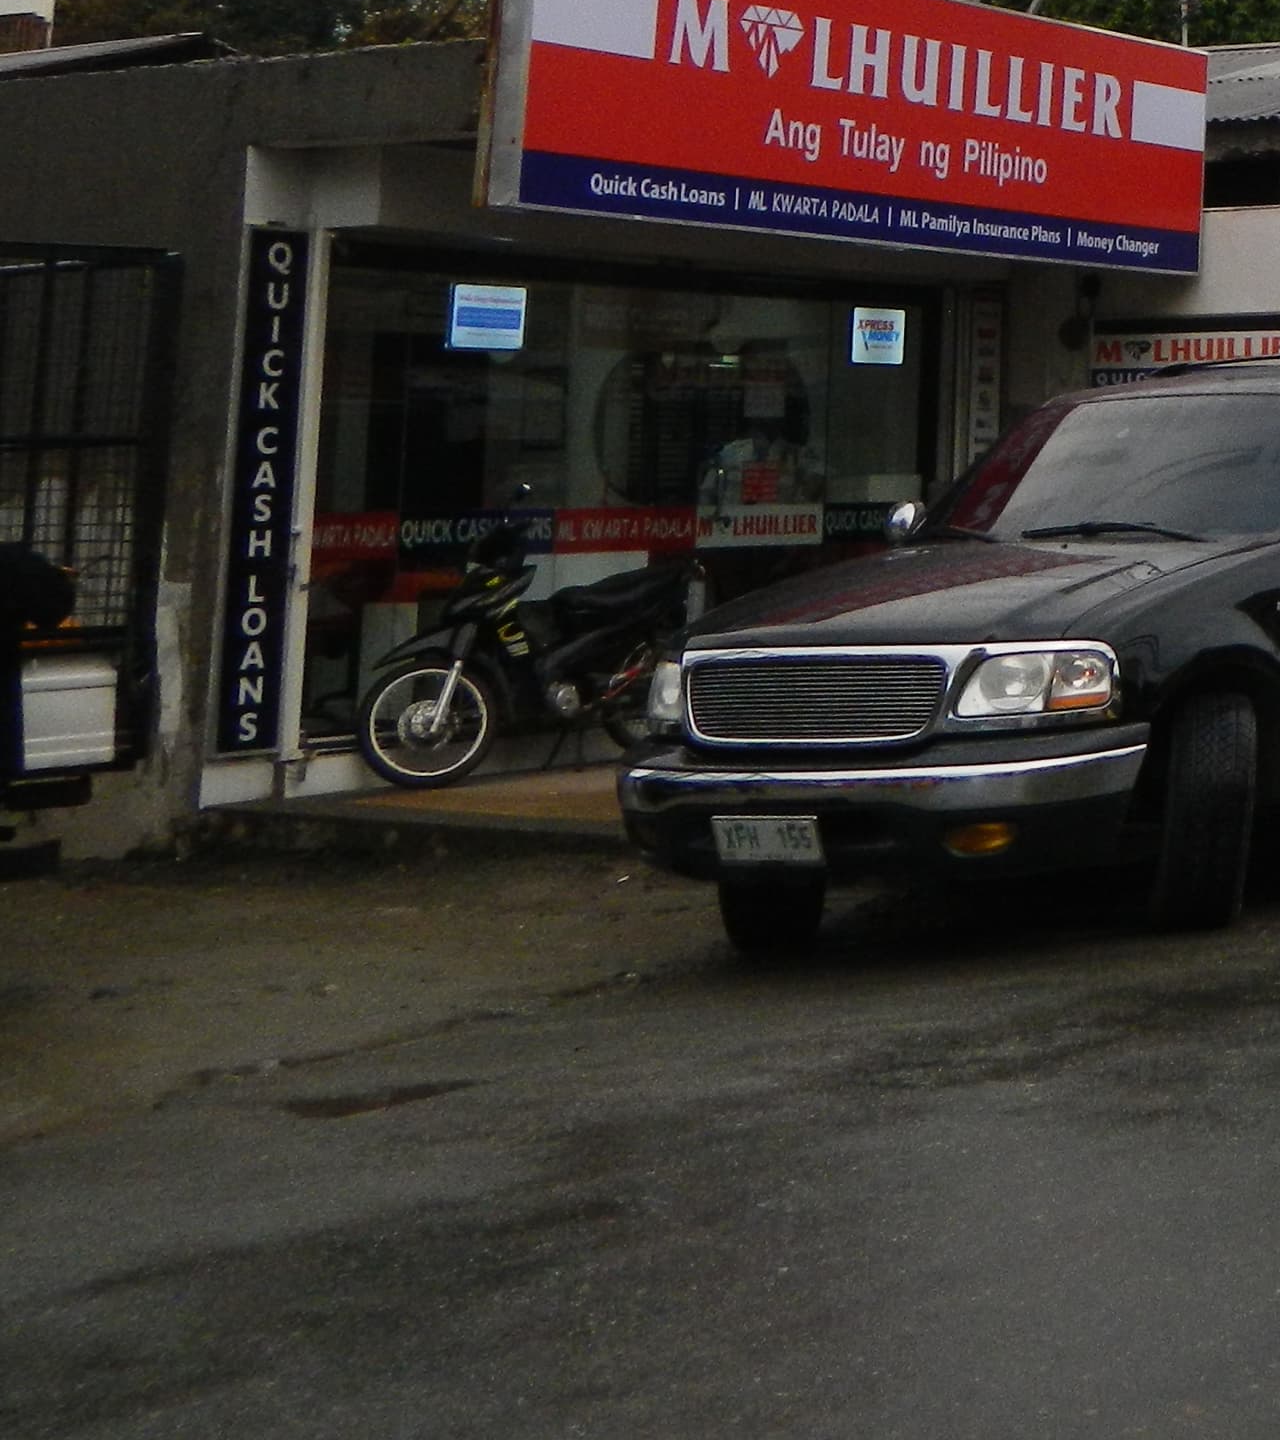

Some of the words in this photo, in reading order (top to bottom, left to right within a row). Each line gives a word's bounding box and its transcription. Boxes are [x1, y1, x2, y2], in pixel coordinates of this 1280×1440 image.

[810, 16, 1123, 140] LHUILLIER
[765, 108, 821, 161] Ang
[839, 118, 905, 173] Tulay
[919, 138, 951, 179] ng
[963, 138, 1049, 186] Pilipino
[590, 172, 637, 200] Quick
[640, 179, 679, 202] Cash
[680, 182, 726, 207] Loans
[748, 191, 768, 211] ML
[772, 193, 828, 219] KWARTA
[831, 199, 880, 225] PADALA
[900, 209, 920, 229] ML
[921, 212, 971, 238] Pamilya
[972, 217, 1030, 241] Insurance
[1030, 223, 1061, 245] Plans
[1076, 230, 1113, 254] Money
[1115, 235, 1160, 257] Changer
[256, 241, 293, 411] QUICK
[246, 426, 279, 559] CASH
[401, 518, 452, 546] QUICK
[581, 518, 639, 543] KWARTA
[642, 516, 693, 541] PADALA
[237, 573, 267, 743] LOANS
